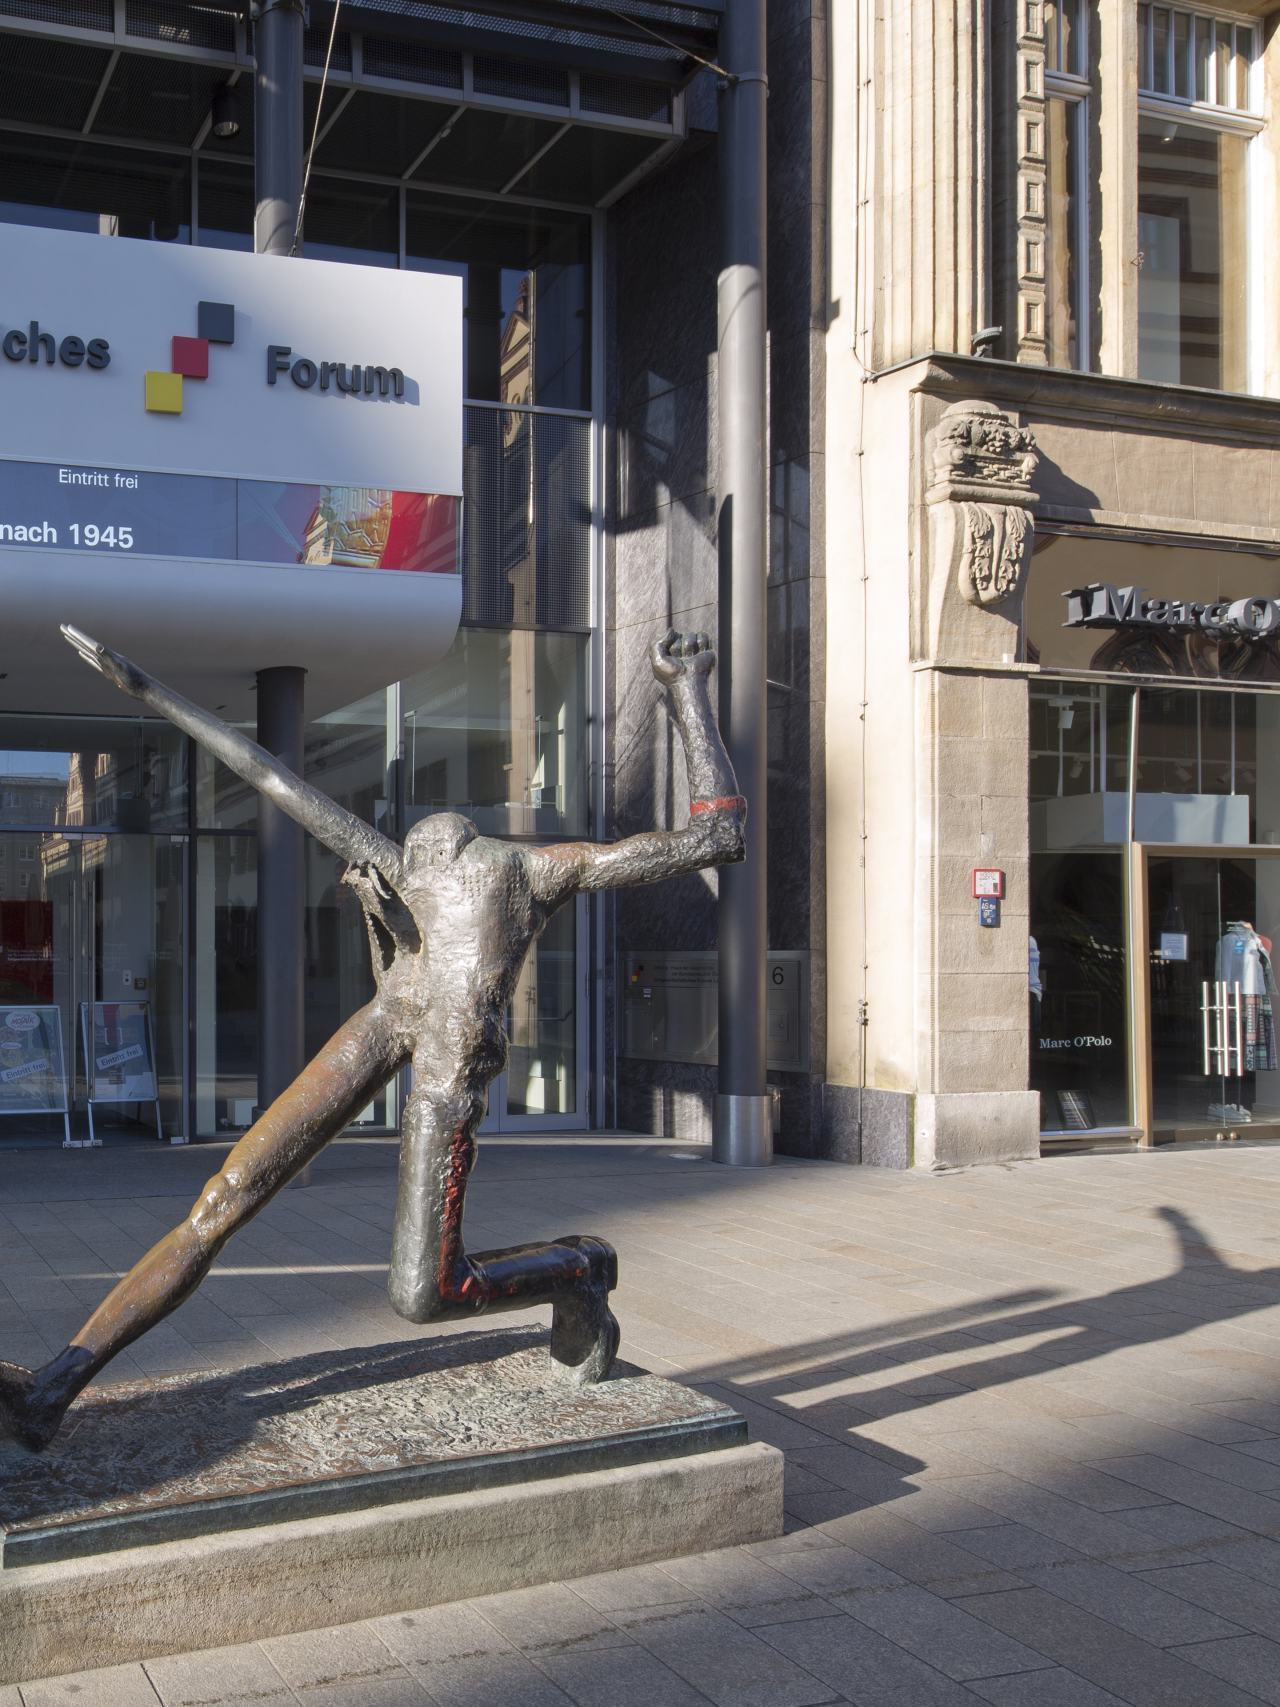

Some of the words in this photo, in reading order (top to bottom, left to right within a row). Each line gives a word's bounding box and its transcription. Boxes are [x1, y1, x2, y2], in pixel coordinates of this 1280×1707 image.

[266, 344, 406, 397] Forum
[59, 468, 109, 487] Eintritt
[114, 473, 138, 489] frei
[69, 523, 134, 549] 1945
[1062, 583, 1226, 629] Marc
[772, 966, 784, 985] 6
[1039, 1037, 1071, 1050] Marc
[1073, 1035, 1113, 1048] O'Polo
